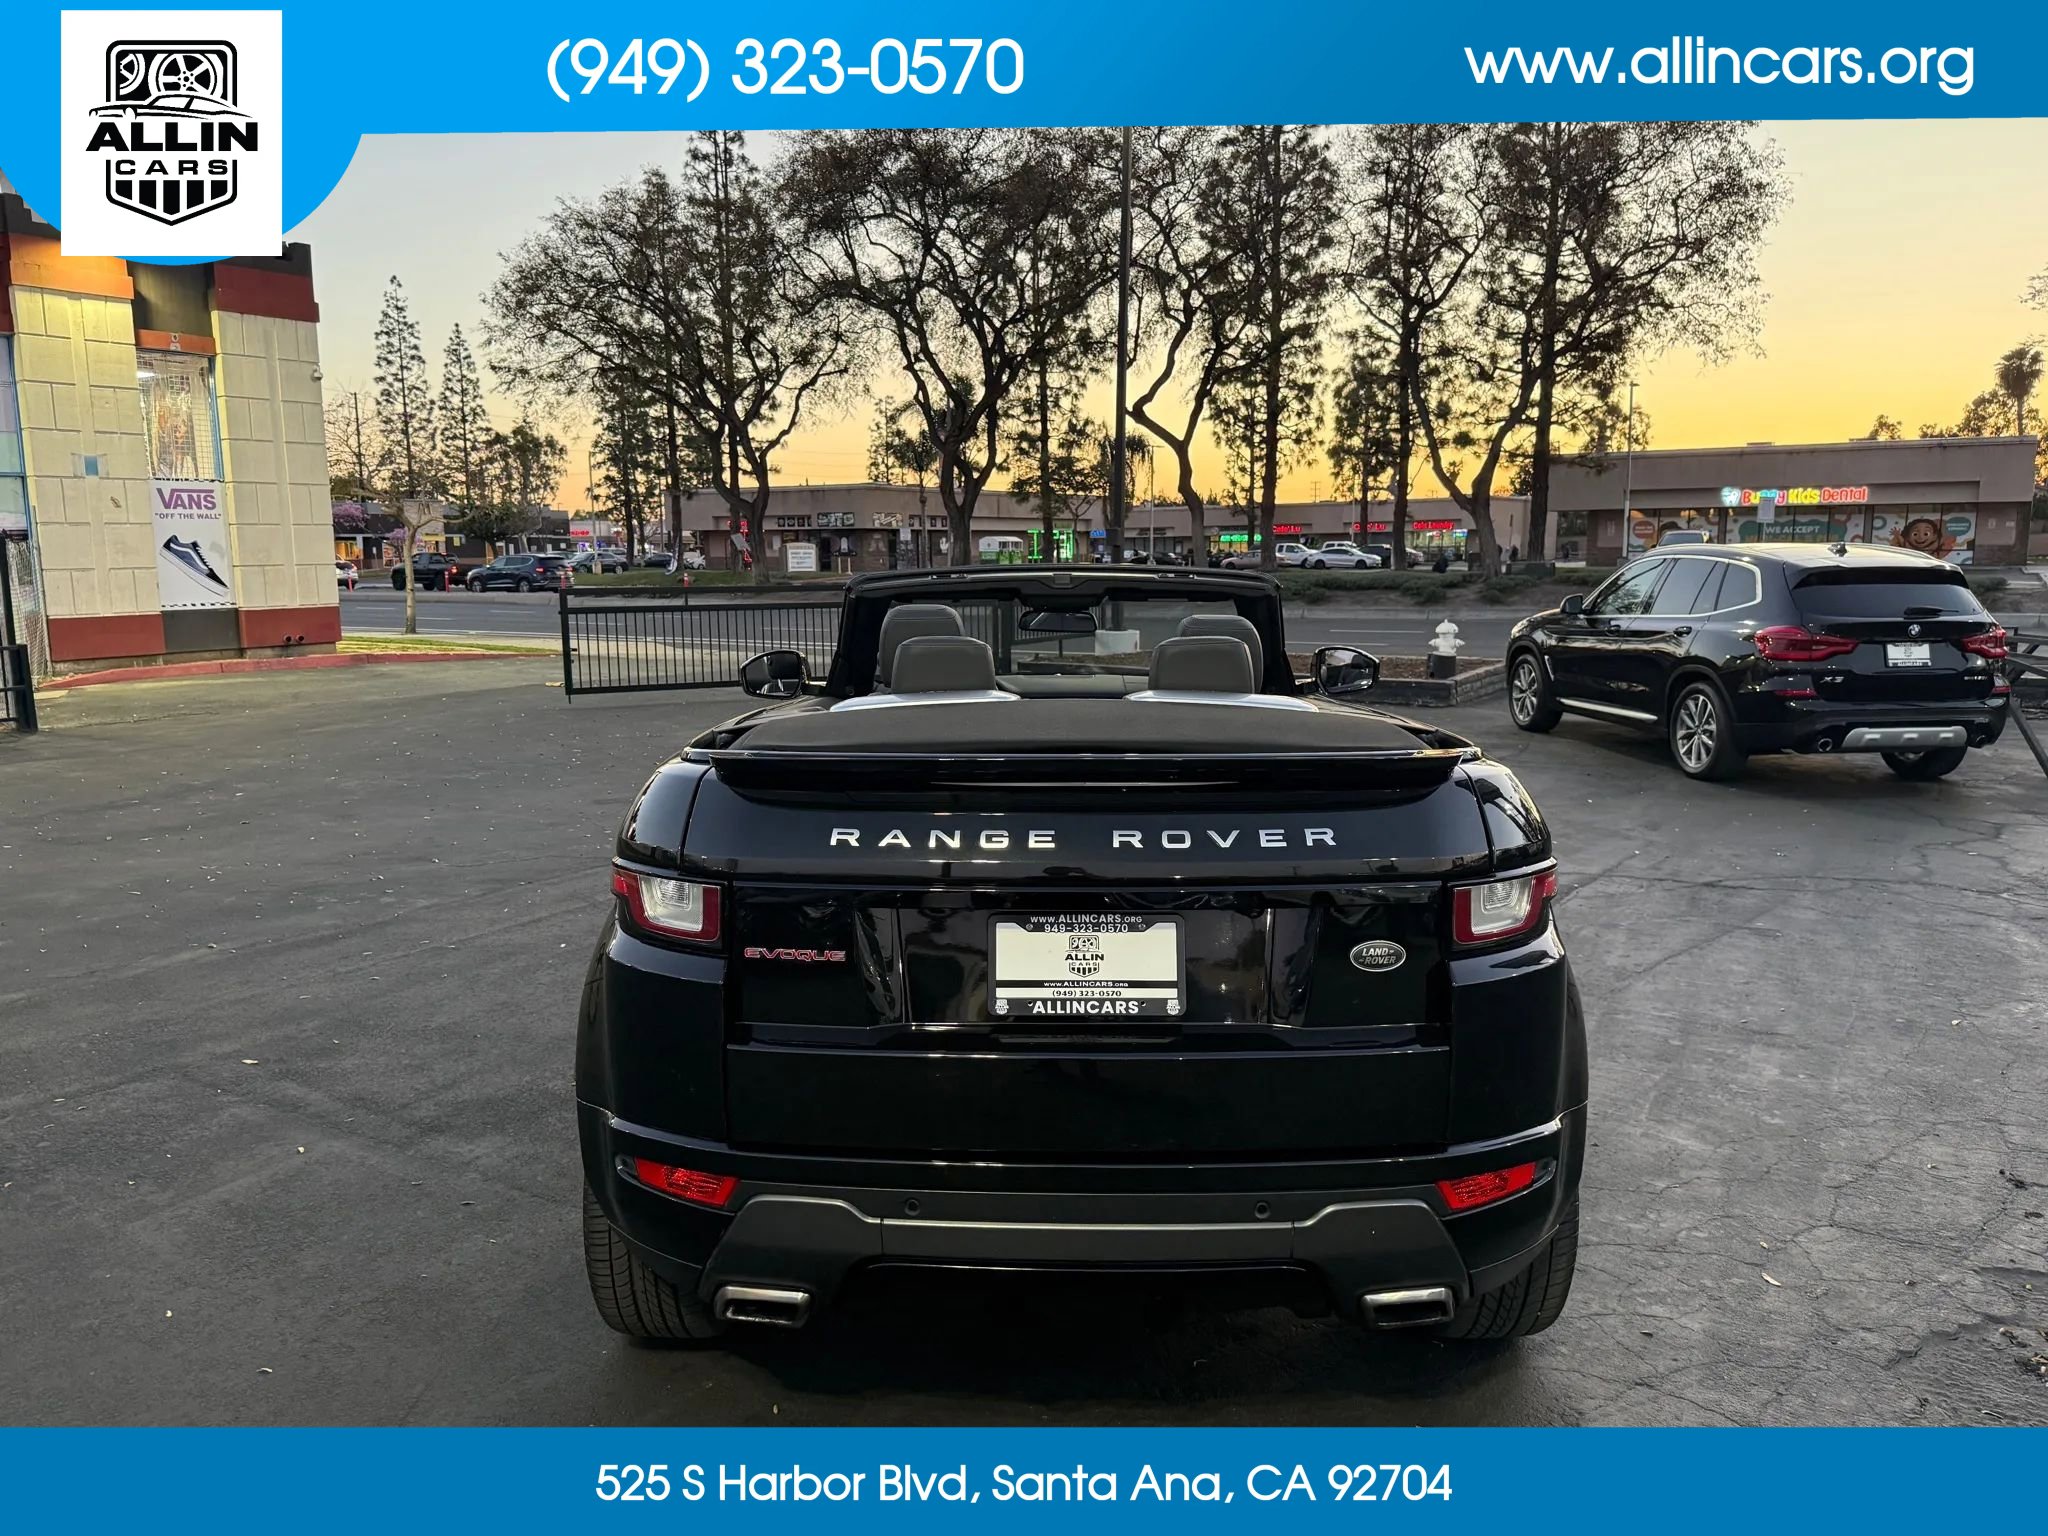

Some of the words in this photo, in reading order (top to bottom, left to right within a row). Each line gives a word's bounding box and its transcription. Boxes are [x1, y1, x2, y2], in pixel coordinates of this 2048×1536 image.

[156, 488, 217, 510] VANS
[1788, 487, 1821, 504] Kids
[1821, 486, 1868, 502] Dental
[1765, 526, 1781, 534] WE
[1782, 525, 1820, 534] ACCEPT
[829, 827, 1056, 850] RANGE
[1112, 827, 1338, 849] ROVER
[1044, 923, 1129, 933] 949-323-0570
[744, 947, 846, 962] EVOQUE
[1065, 953, 1105, 961] ALLIN
[1362, 947, 1389, 956] LAND
[1364, 956, 1397, 965] ROVER
[1032, 1000, 1139, 1014] ALLINCARS
